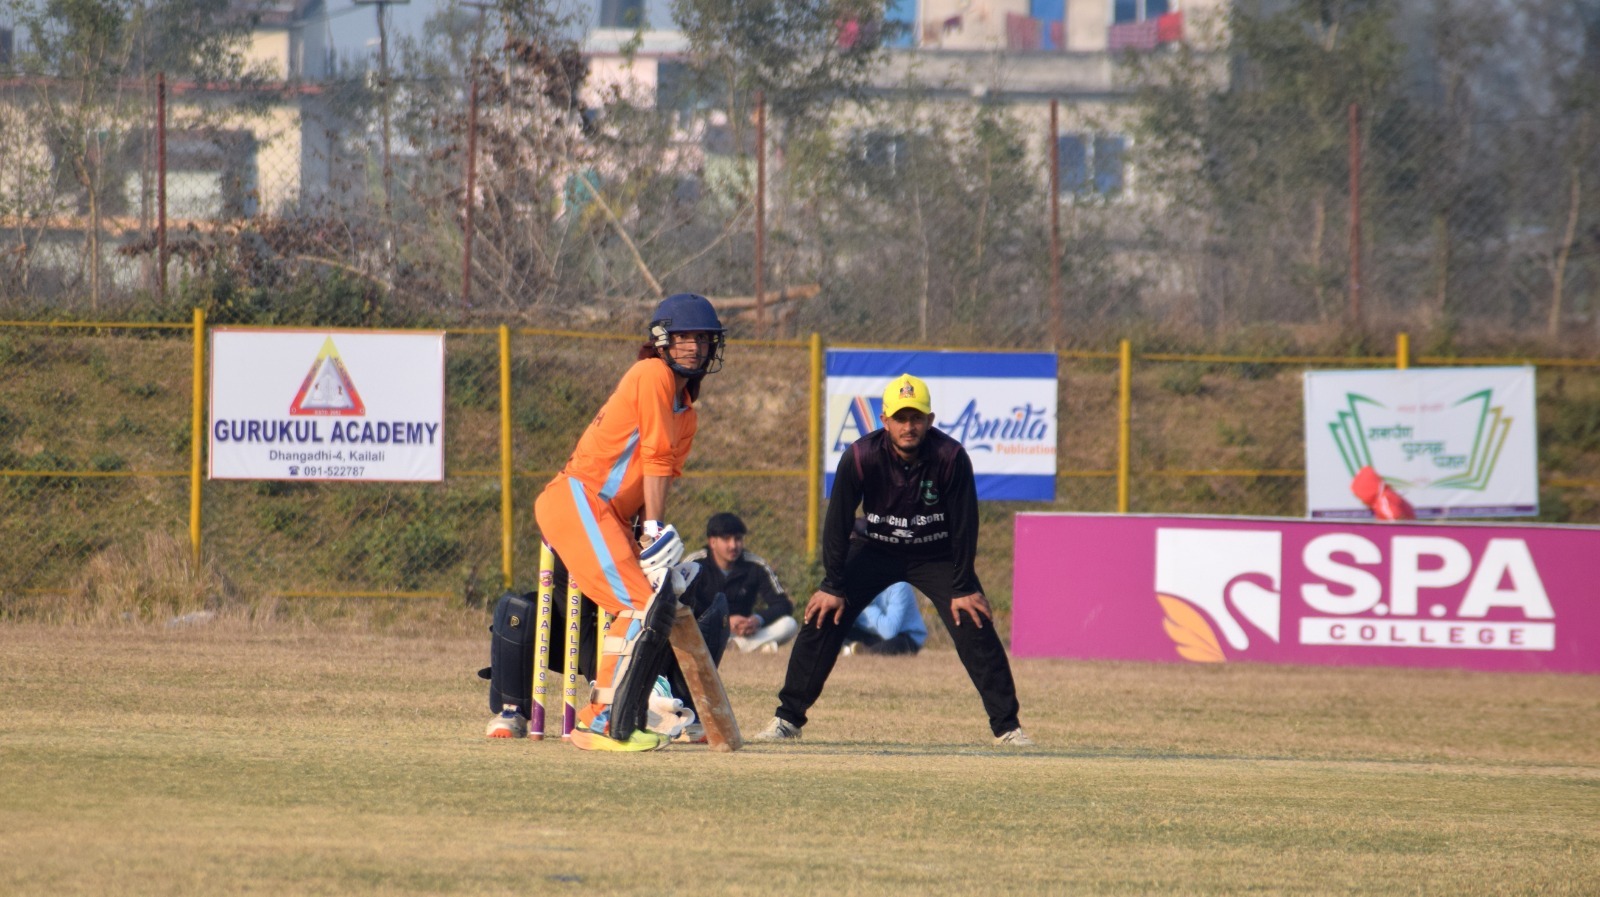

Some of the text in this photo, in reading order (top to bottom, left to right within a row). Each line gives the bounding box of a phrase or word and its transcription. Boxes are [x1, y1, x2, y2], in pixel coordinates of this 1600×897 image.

[214, 419, 439, 445] GURUKUL ACADEMY
[938, 398, 1048, 446] Asmita
[269, 450, 385, 463] Dhangadhi-4, Kailali
[996, 443, 1056, 456] Publication
[304, 466, 365, 477] 091-522787
[1300, 533, 1556, 619] S.P.A
[1329, 624, 1526, 646] COLLEGE
